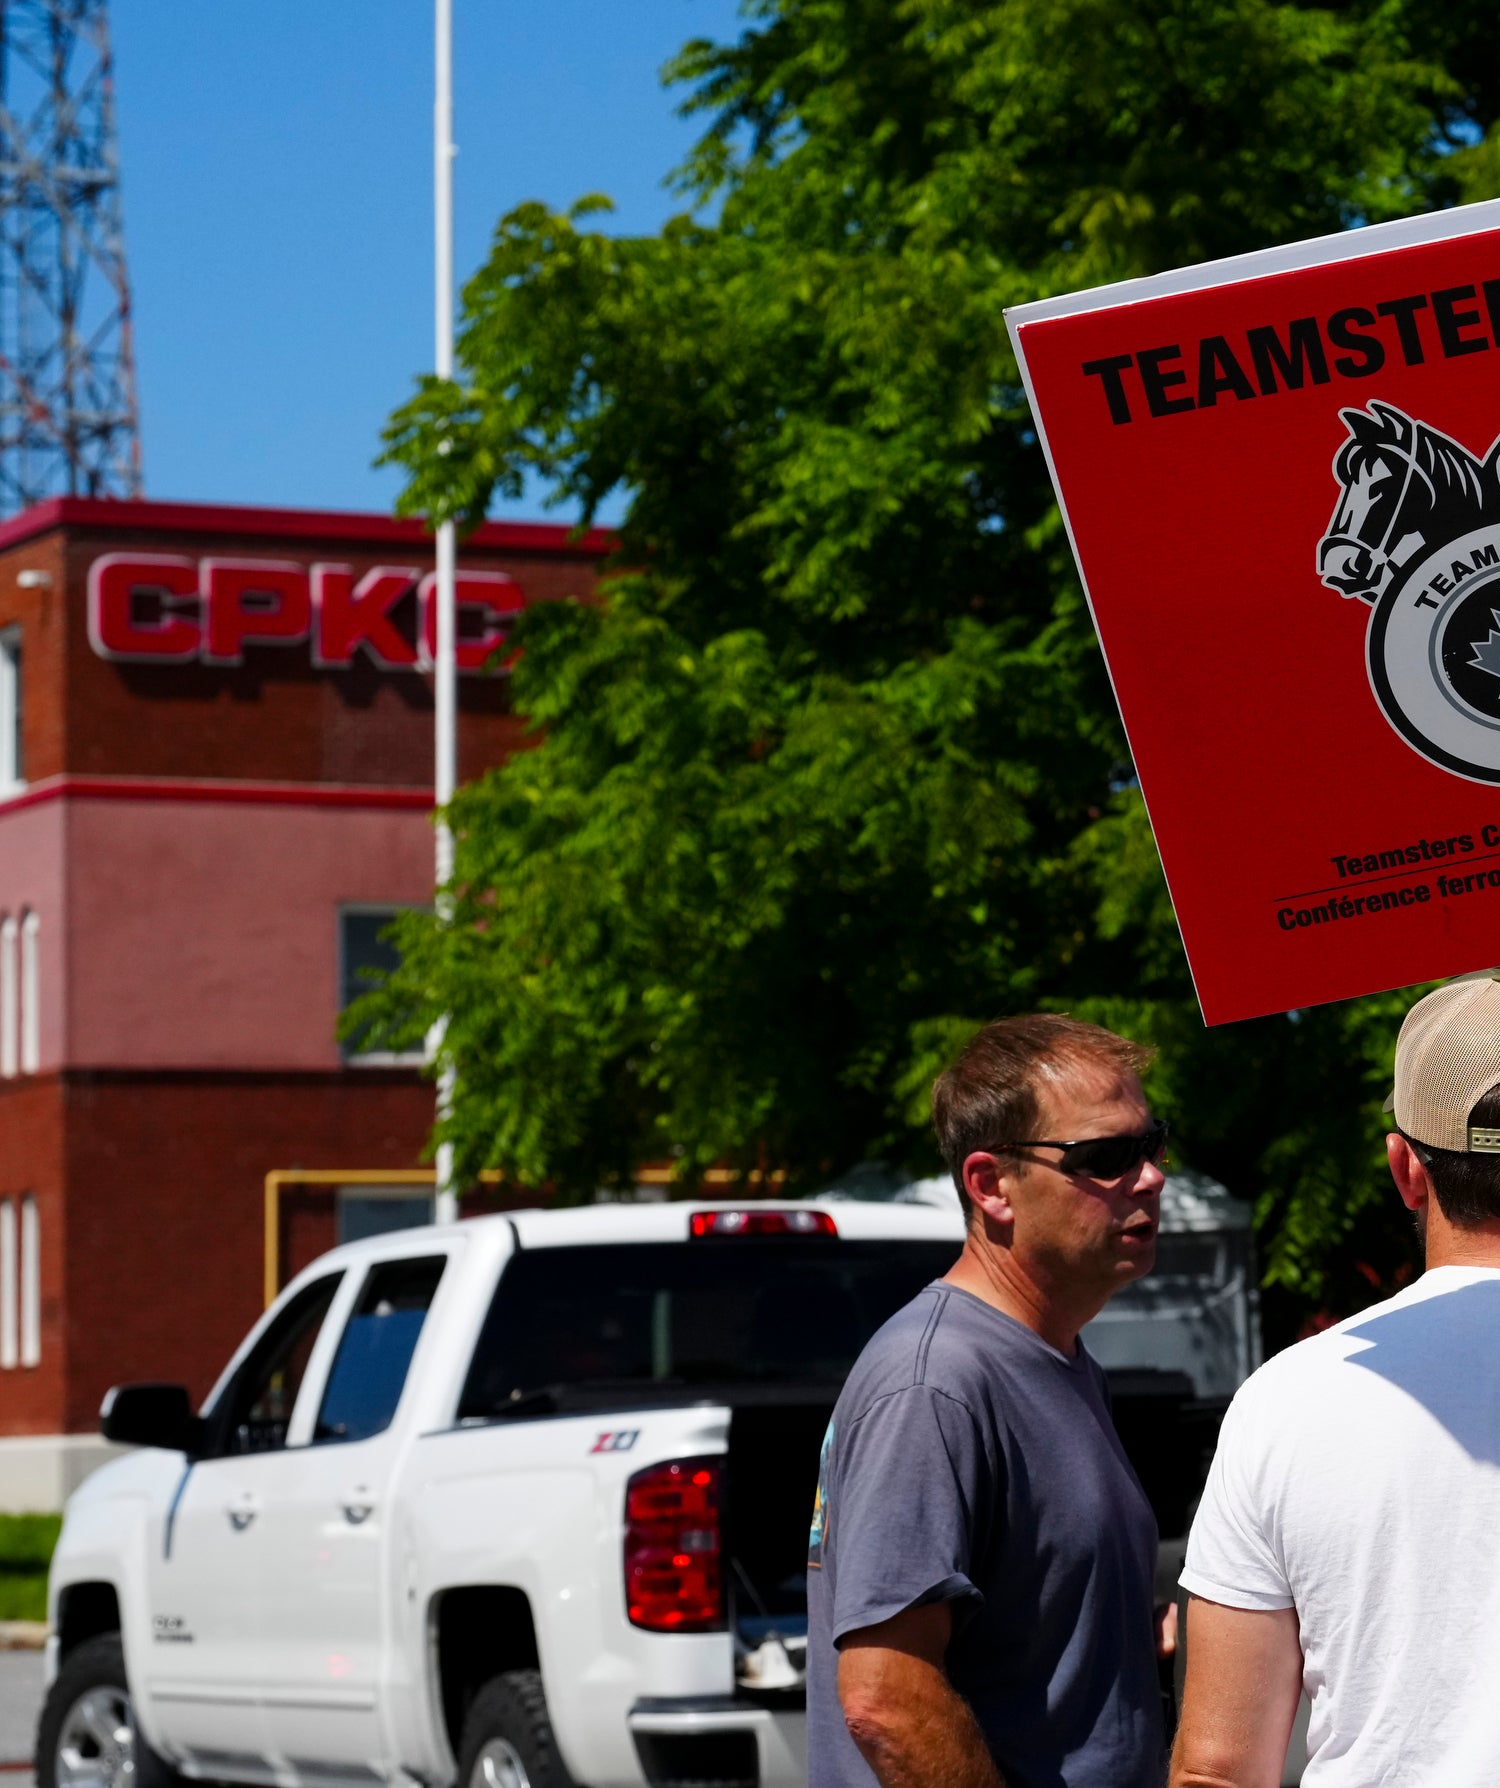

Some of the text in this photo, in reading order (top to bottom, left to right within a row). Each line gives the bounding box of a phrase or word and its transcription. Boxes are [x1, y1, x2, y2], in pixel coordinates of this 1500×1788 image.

[88, 552, 525, 675] CPKC
[1331, 833, 1474, 878] Teamsters
[1277, 884, 1431, 931] Conférence
